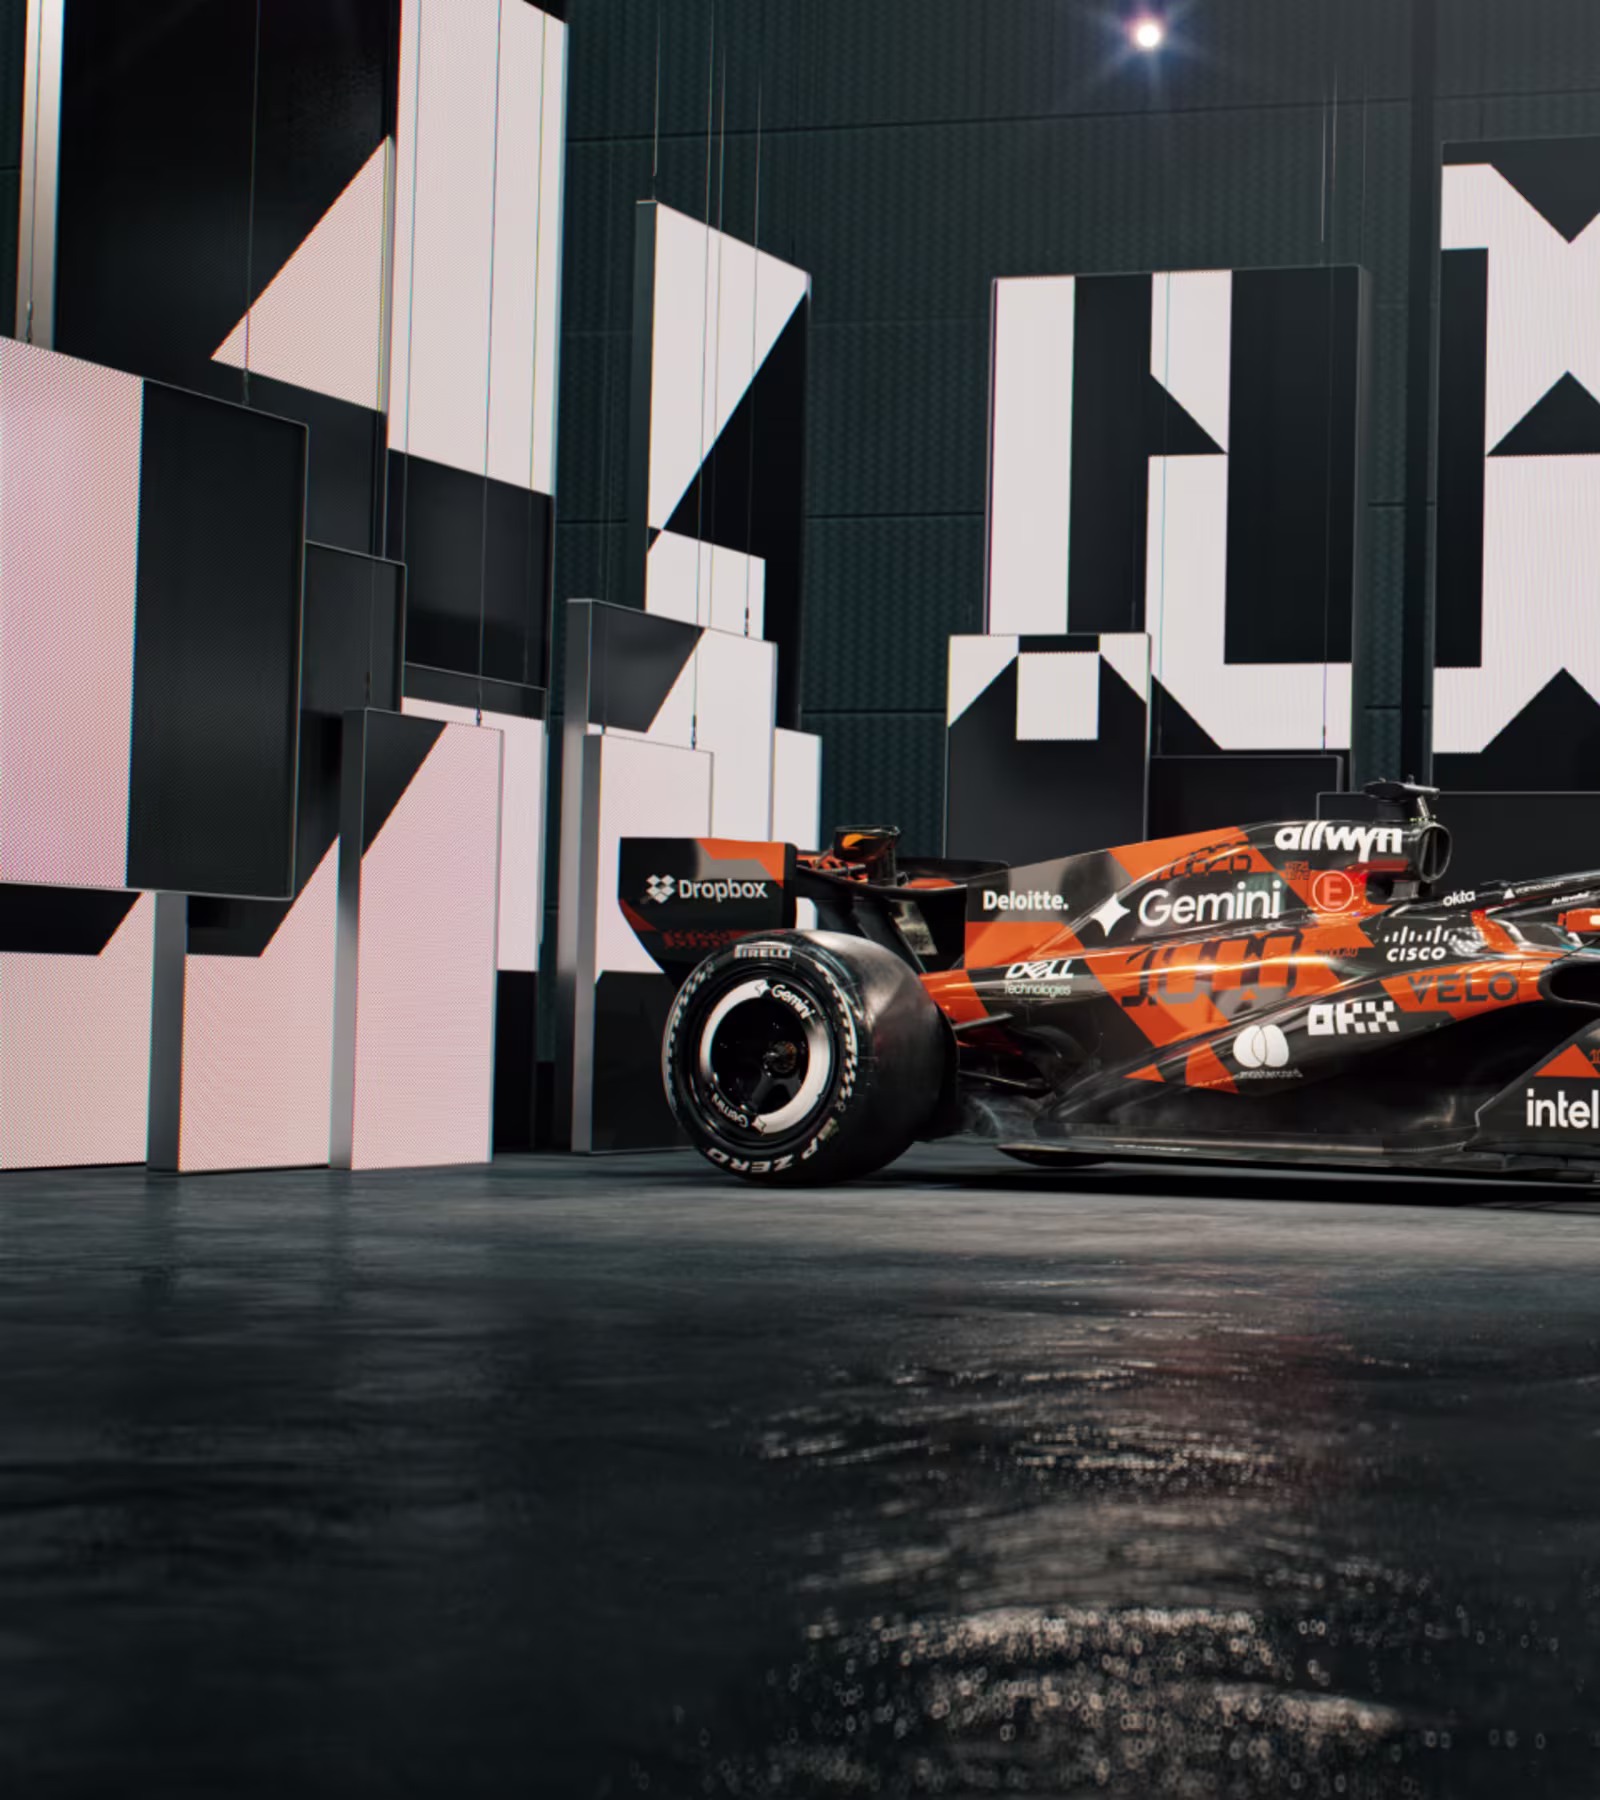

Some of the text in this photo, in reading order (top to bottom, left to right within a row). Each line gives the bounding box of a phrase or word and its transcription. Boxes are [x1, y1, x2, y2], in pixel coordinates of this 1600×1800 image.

[1275, 821, 1402, 862] allwyn
[679, 878, 768, 902] Dropbox
[983, 890, 1069, 911] Deloitte.
[1138, 880, 1282, 927] Gemini
[1442, 890, 1476, 907] okta
[734, 944, 793, 959] PIRELLI
[1005, 960, 1074, 980] DELL
[771, 984, 814, 1020] Gemini
[1407, 971, 1519, 1004] VELO
[1308, 1001, 1399, 1035] OKX
[711, 1092, 749, 1128] Gemini
[1526, 1088, 1599, 1129] intel
[706, 1148, 794, 1173] ZERO
